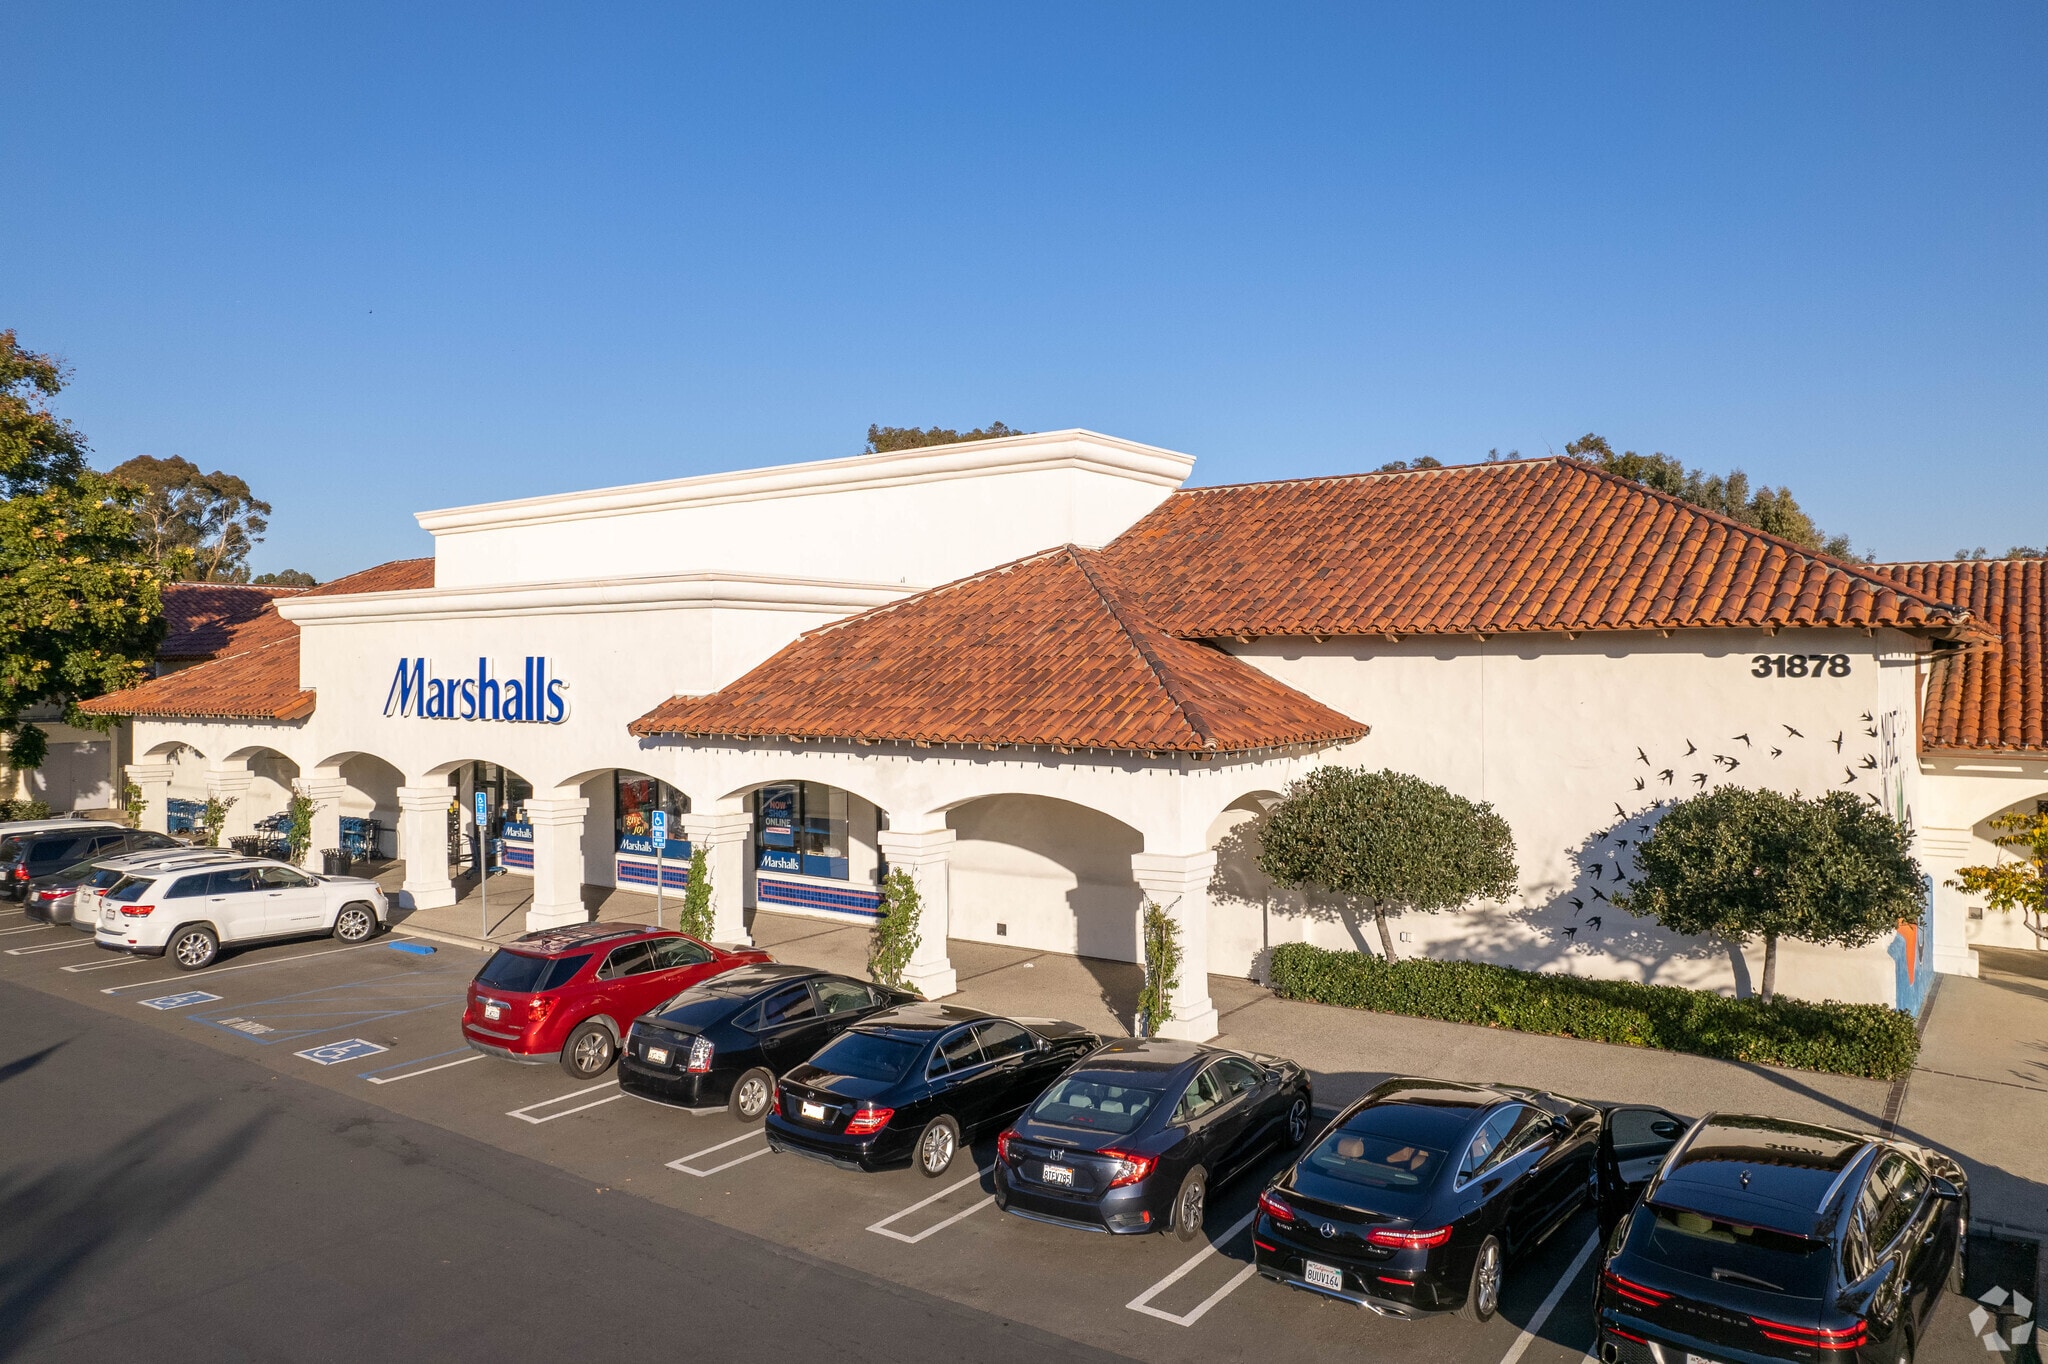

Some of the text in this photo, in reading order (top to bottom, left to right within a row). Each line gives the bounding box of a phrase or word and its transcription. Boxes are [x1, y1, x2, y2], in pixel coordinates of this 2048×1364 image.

[1750, 653, 1852, 678] 31878
[383, 656, 567, 723] Marshalls
[769, 800, 787, 809] NOW
[625, 814, 642, 826] give
[768, 809, 788, 818] SHOP
[765, 817, 792, 827] ONLINE
[504, 826, 533, 839] Marshalls
[632, 823, 645, 836] joy
[620, 838, 652, 853] Marshalls
[760, 855, 799, 870] Marshalls
[1307, 1269, 1339, 1287] 8UUV164
